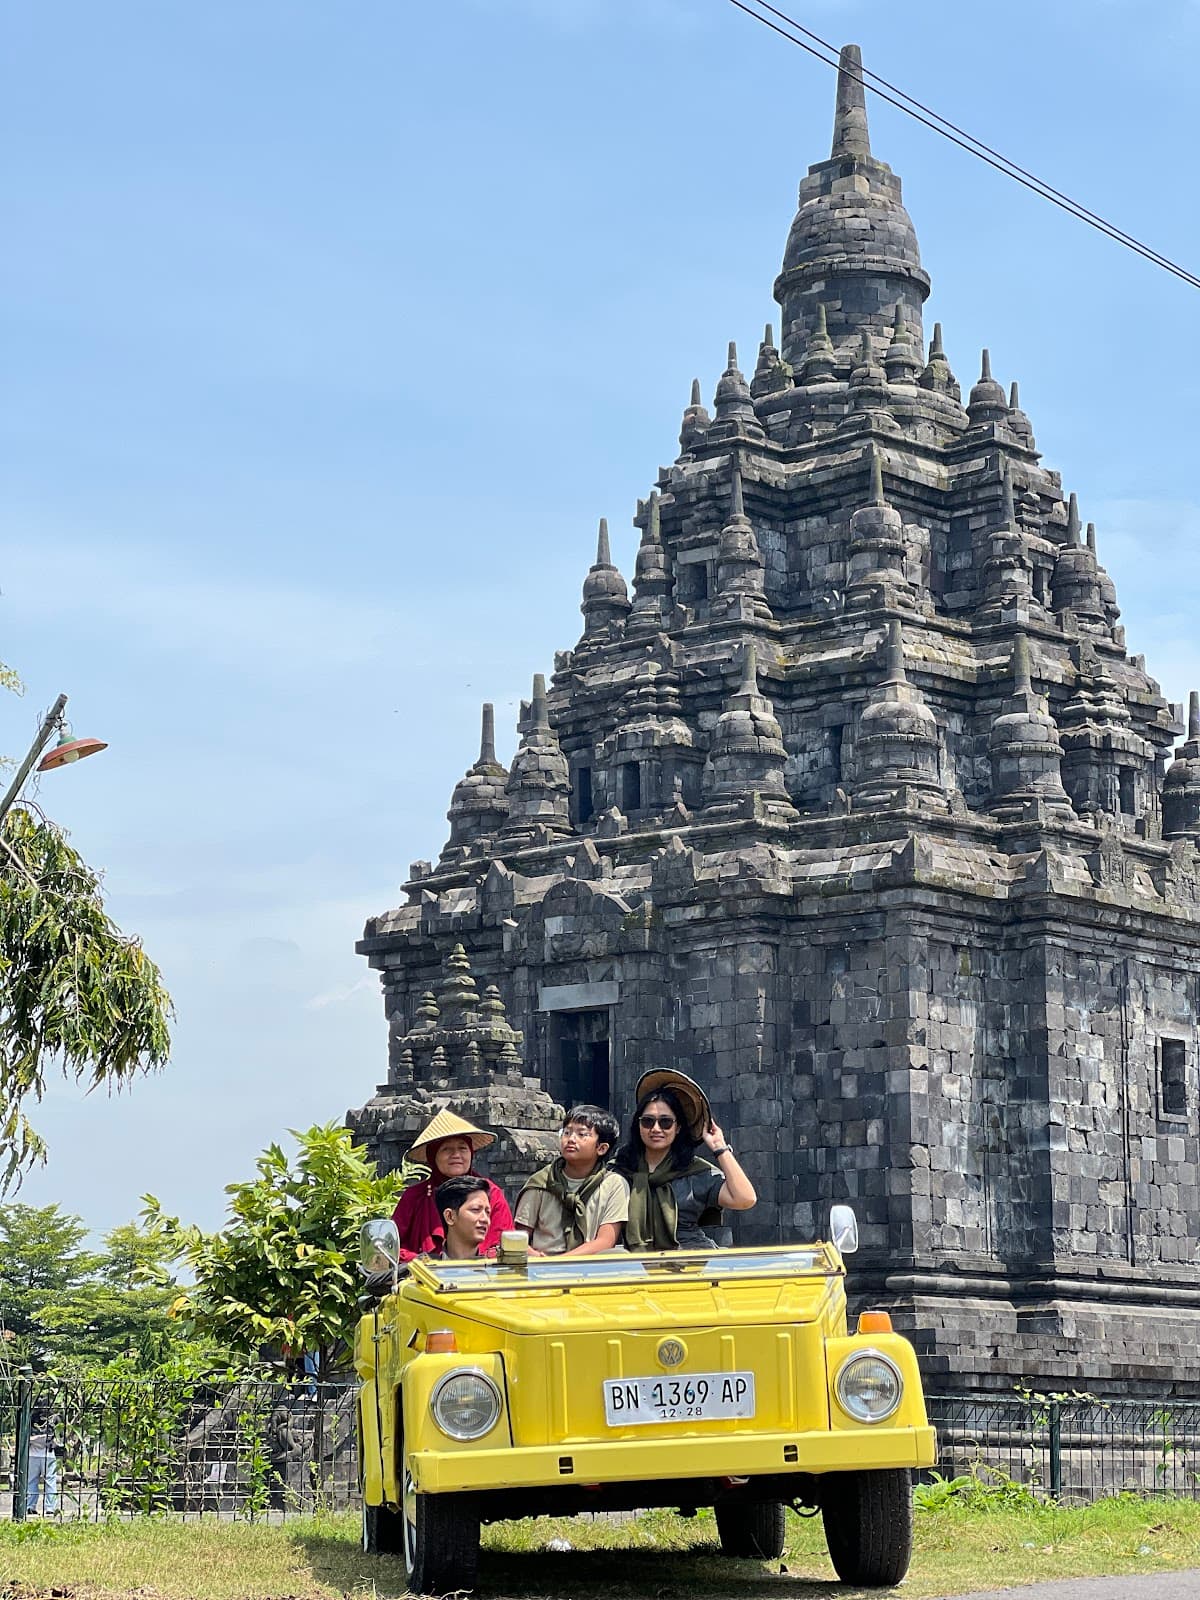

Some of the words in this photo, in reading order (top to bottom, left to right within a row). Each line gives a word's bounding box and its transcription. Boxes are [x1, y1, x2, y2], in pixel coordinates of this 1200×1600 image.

[611, 1385, 639, 1410] BN
[653, 1380, 709, 1407] 1369
[721, 1378, 747, 1403] AP
